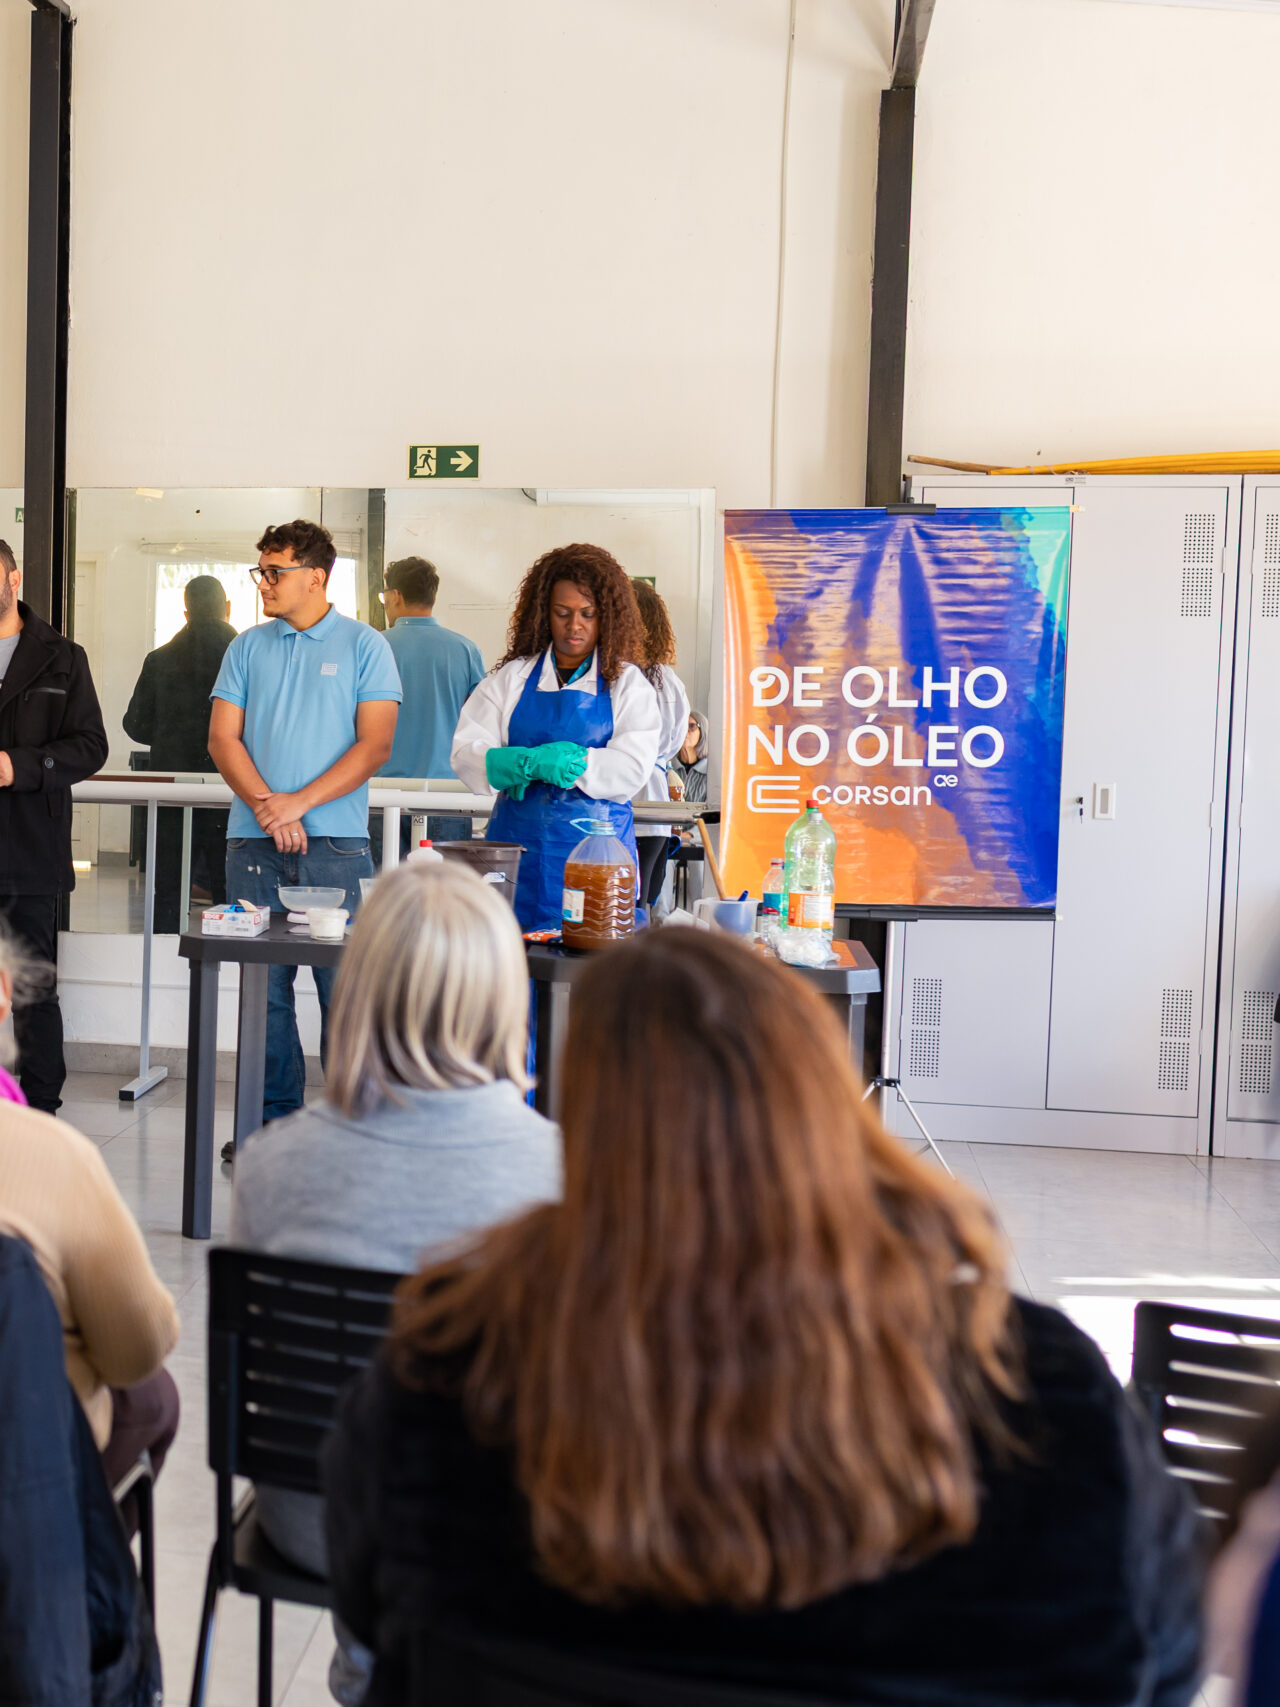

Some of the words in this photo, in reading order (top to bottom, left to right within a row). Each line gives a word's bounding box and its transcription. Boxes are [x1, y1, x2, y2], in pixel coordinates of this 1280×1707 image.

[749, 666, 824, 707] DE
[841, 665, 1008, 709] OLHO
[747, 724, 831, 767] NO
[846, 713, 1005, 768] ÓLEO
